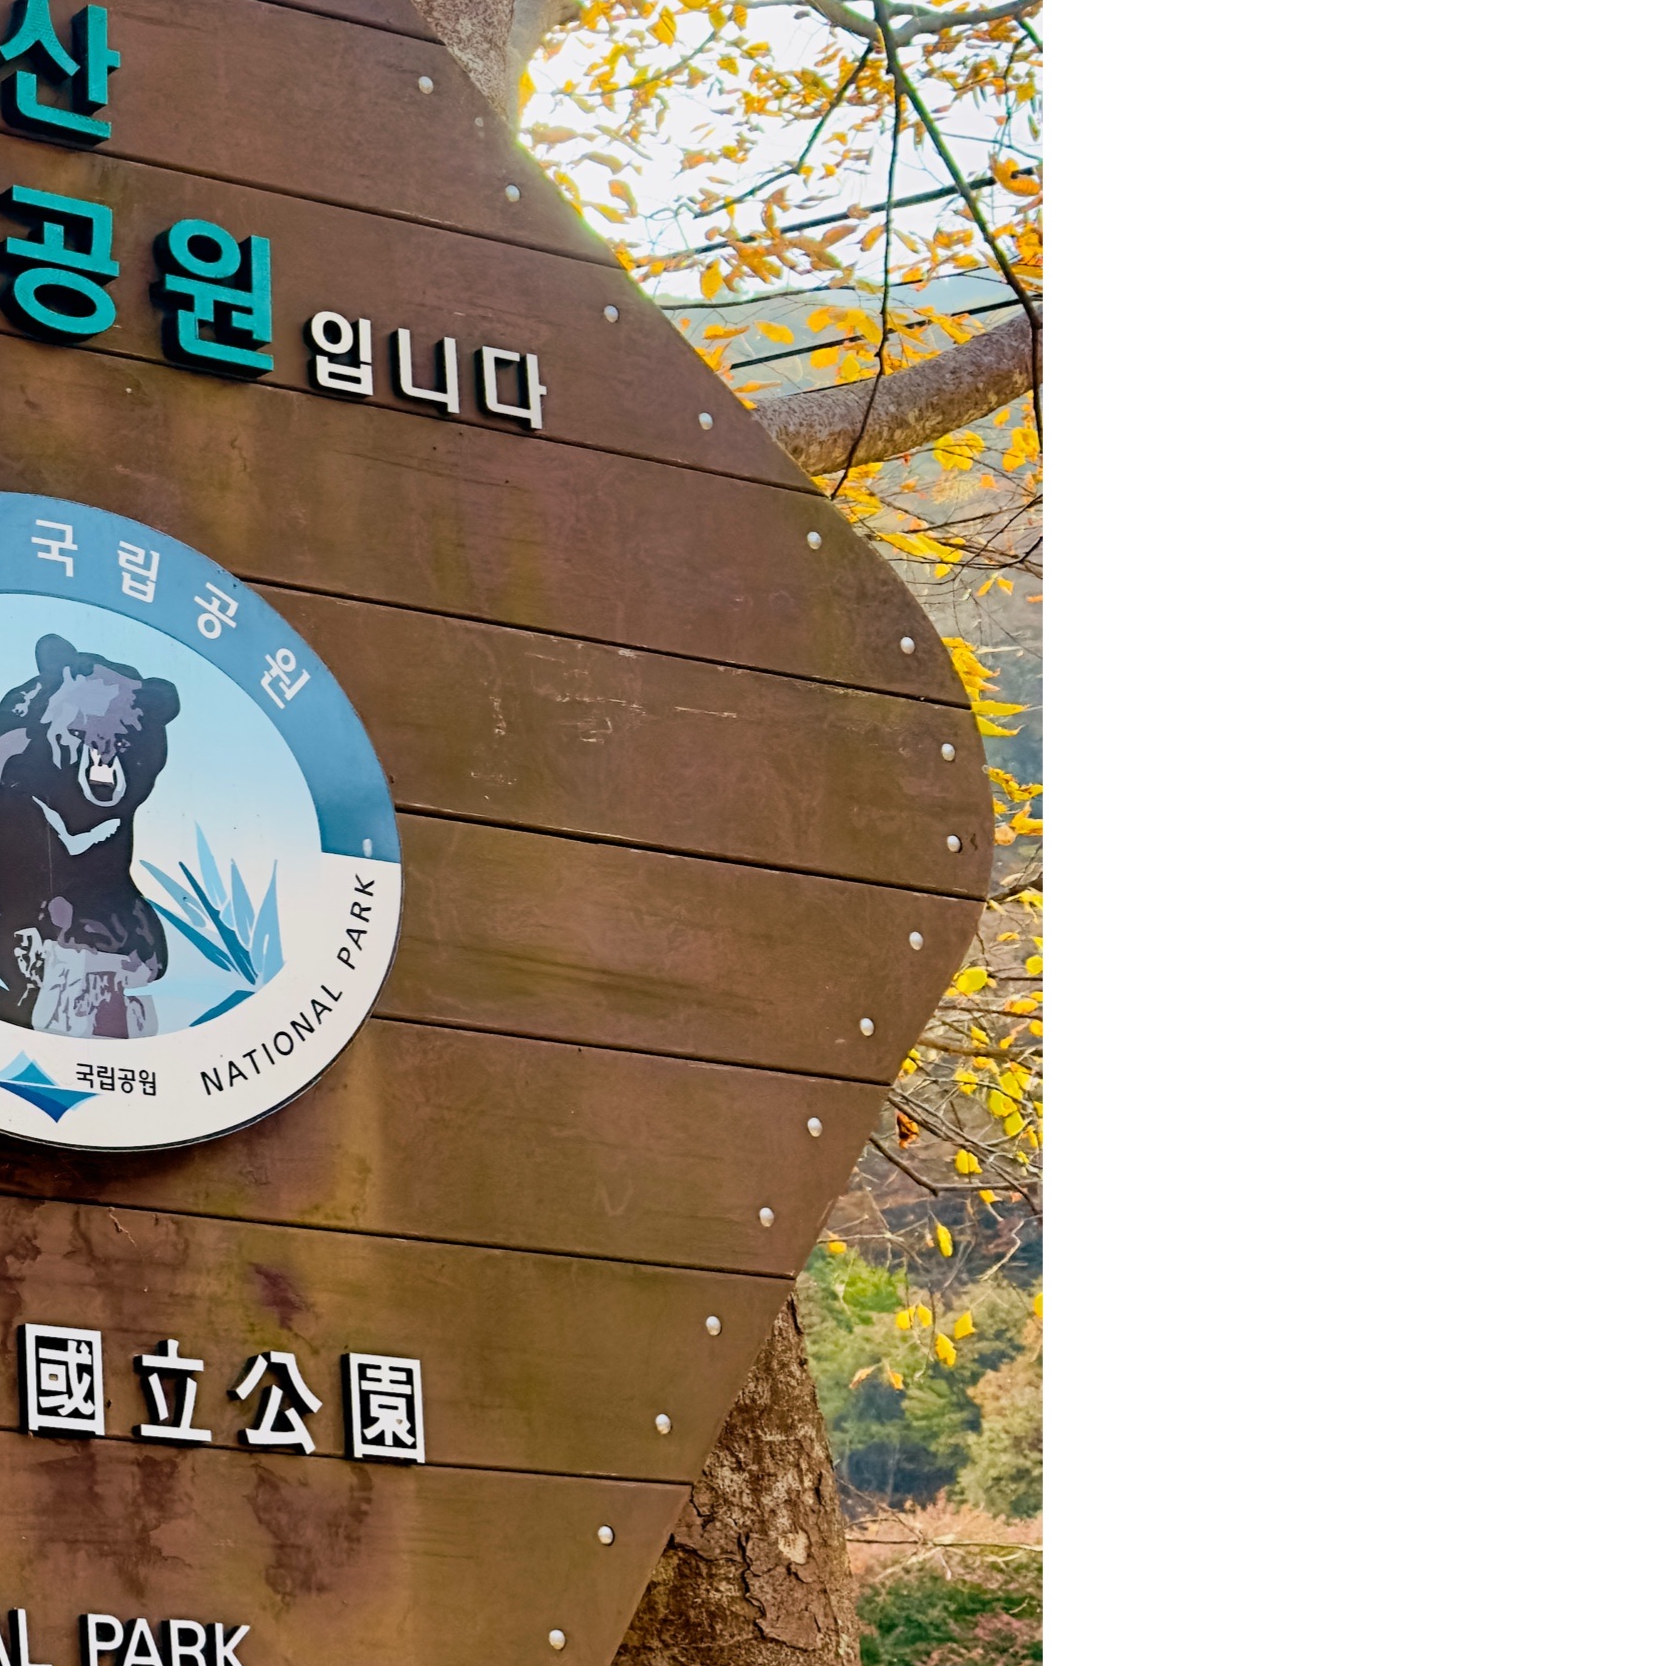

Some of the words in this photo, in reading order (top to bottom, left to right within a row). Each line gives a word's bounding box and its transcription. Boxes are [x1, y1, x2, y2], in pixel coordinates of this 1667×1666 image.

[308, 309, 548, 431] 입니다
[199, 983, 344, 1096] NATIONAL
[343, 873, 376, 970] PARK
[75, 1062, 158, 1097] 국립공원
